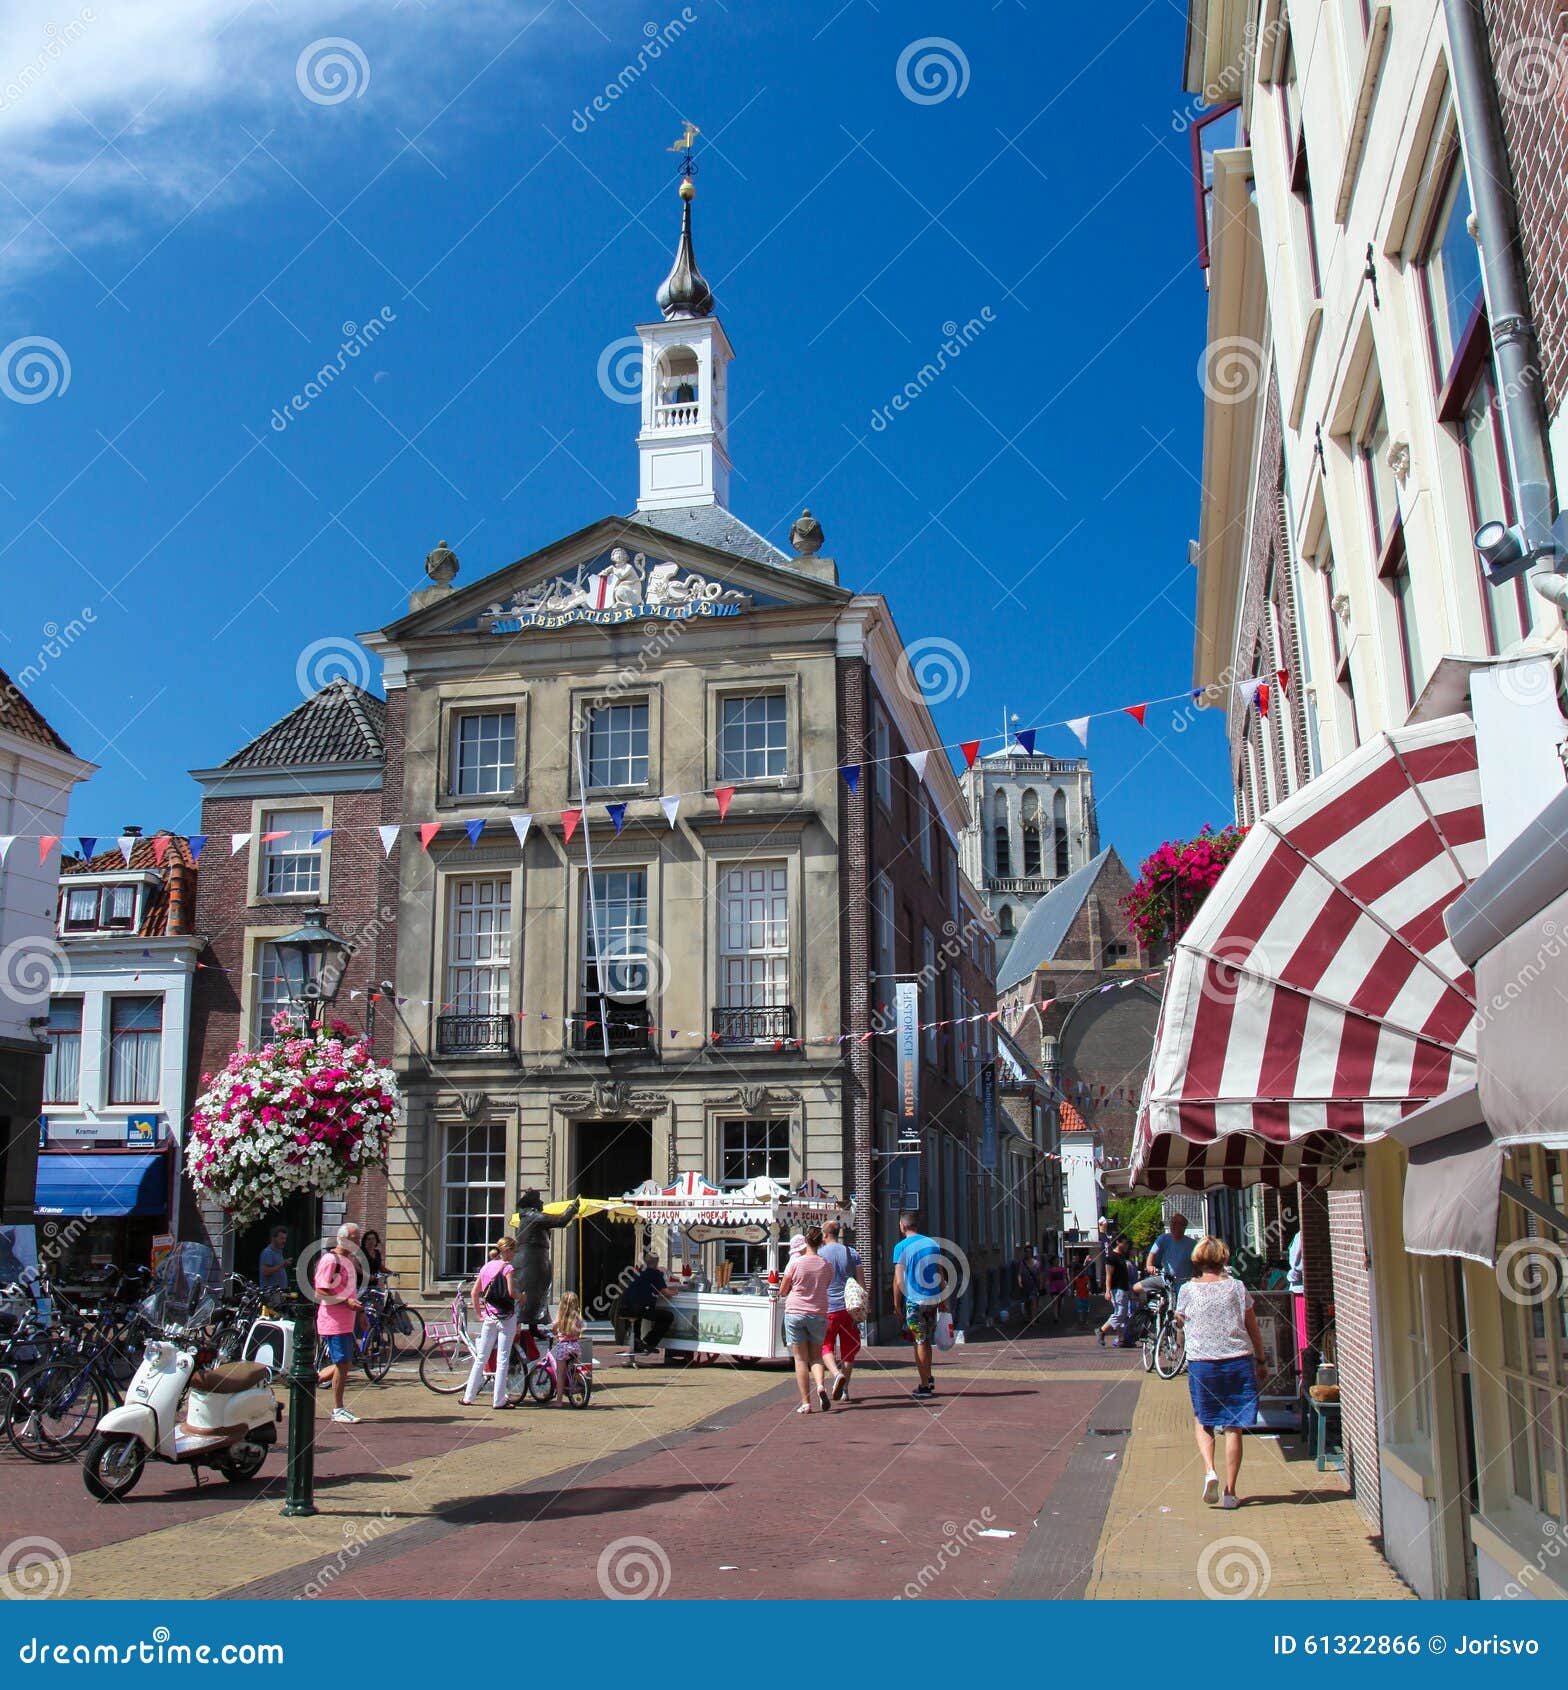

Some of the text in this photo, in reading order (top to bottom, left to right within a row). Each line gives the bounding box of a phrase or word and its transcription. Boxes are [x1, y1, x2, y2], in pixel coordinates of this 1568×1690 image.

[903, 991, 913, 1056] HISTORISCH
[904, 1060, 914, 1117] MUSEUM
[75, 1127, 99, 1135] Kramer
[39, 1206, 64, 1214] Kramer
